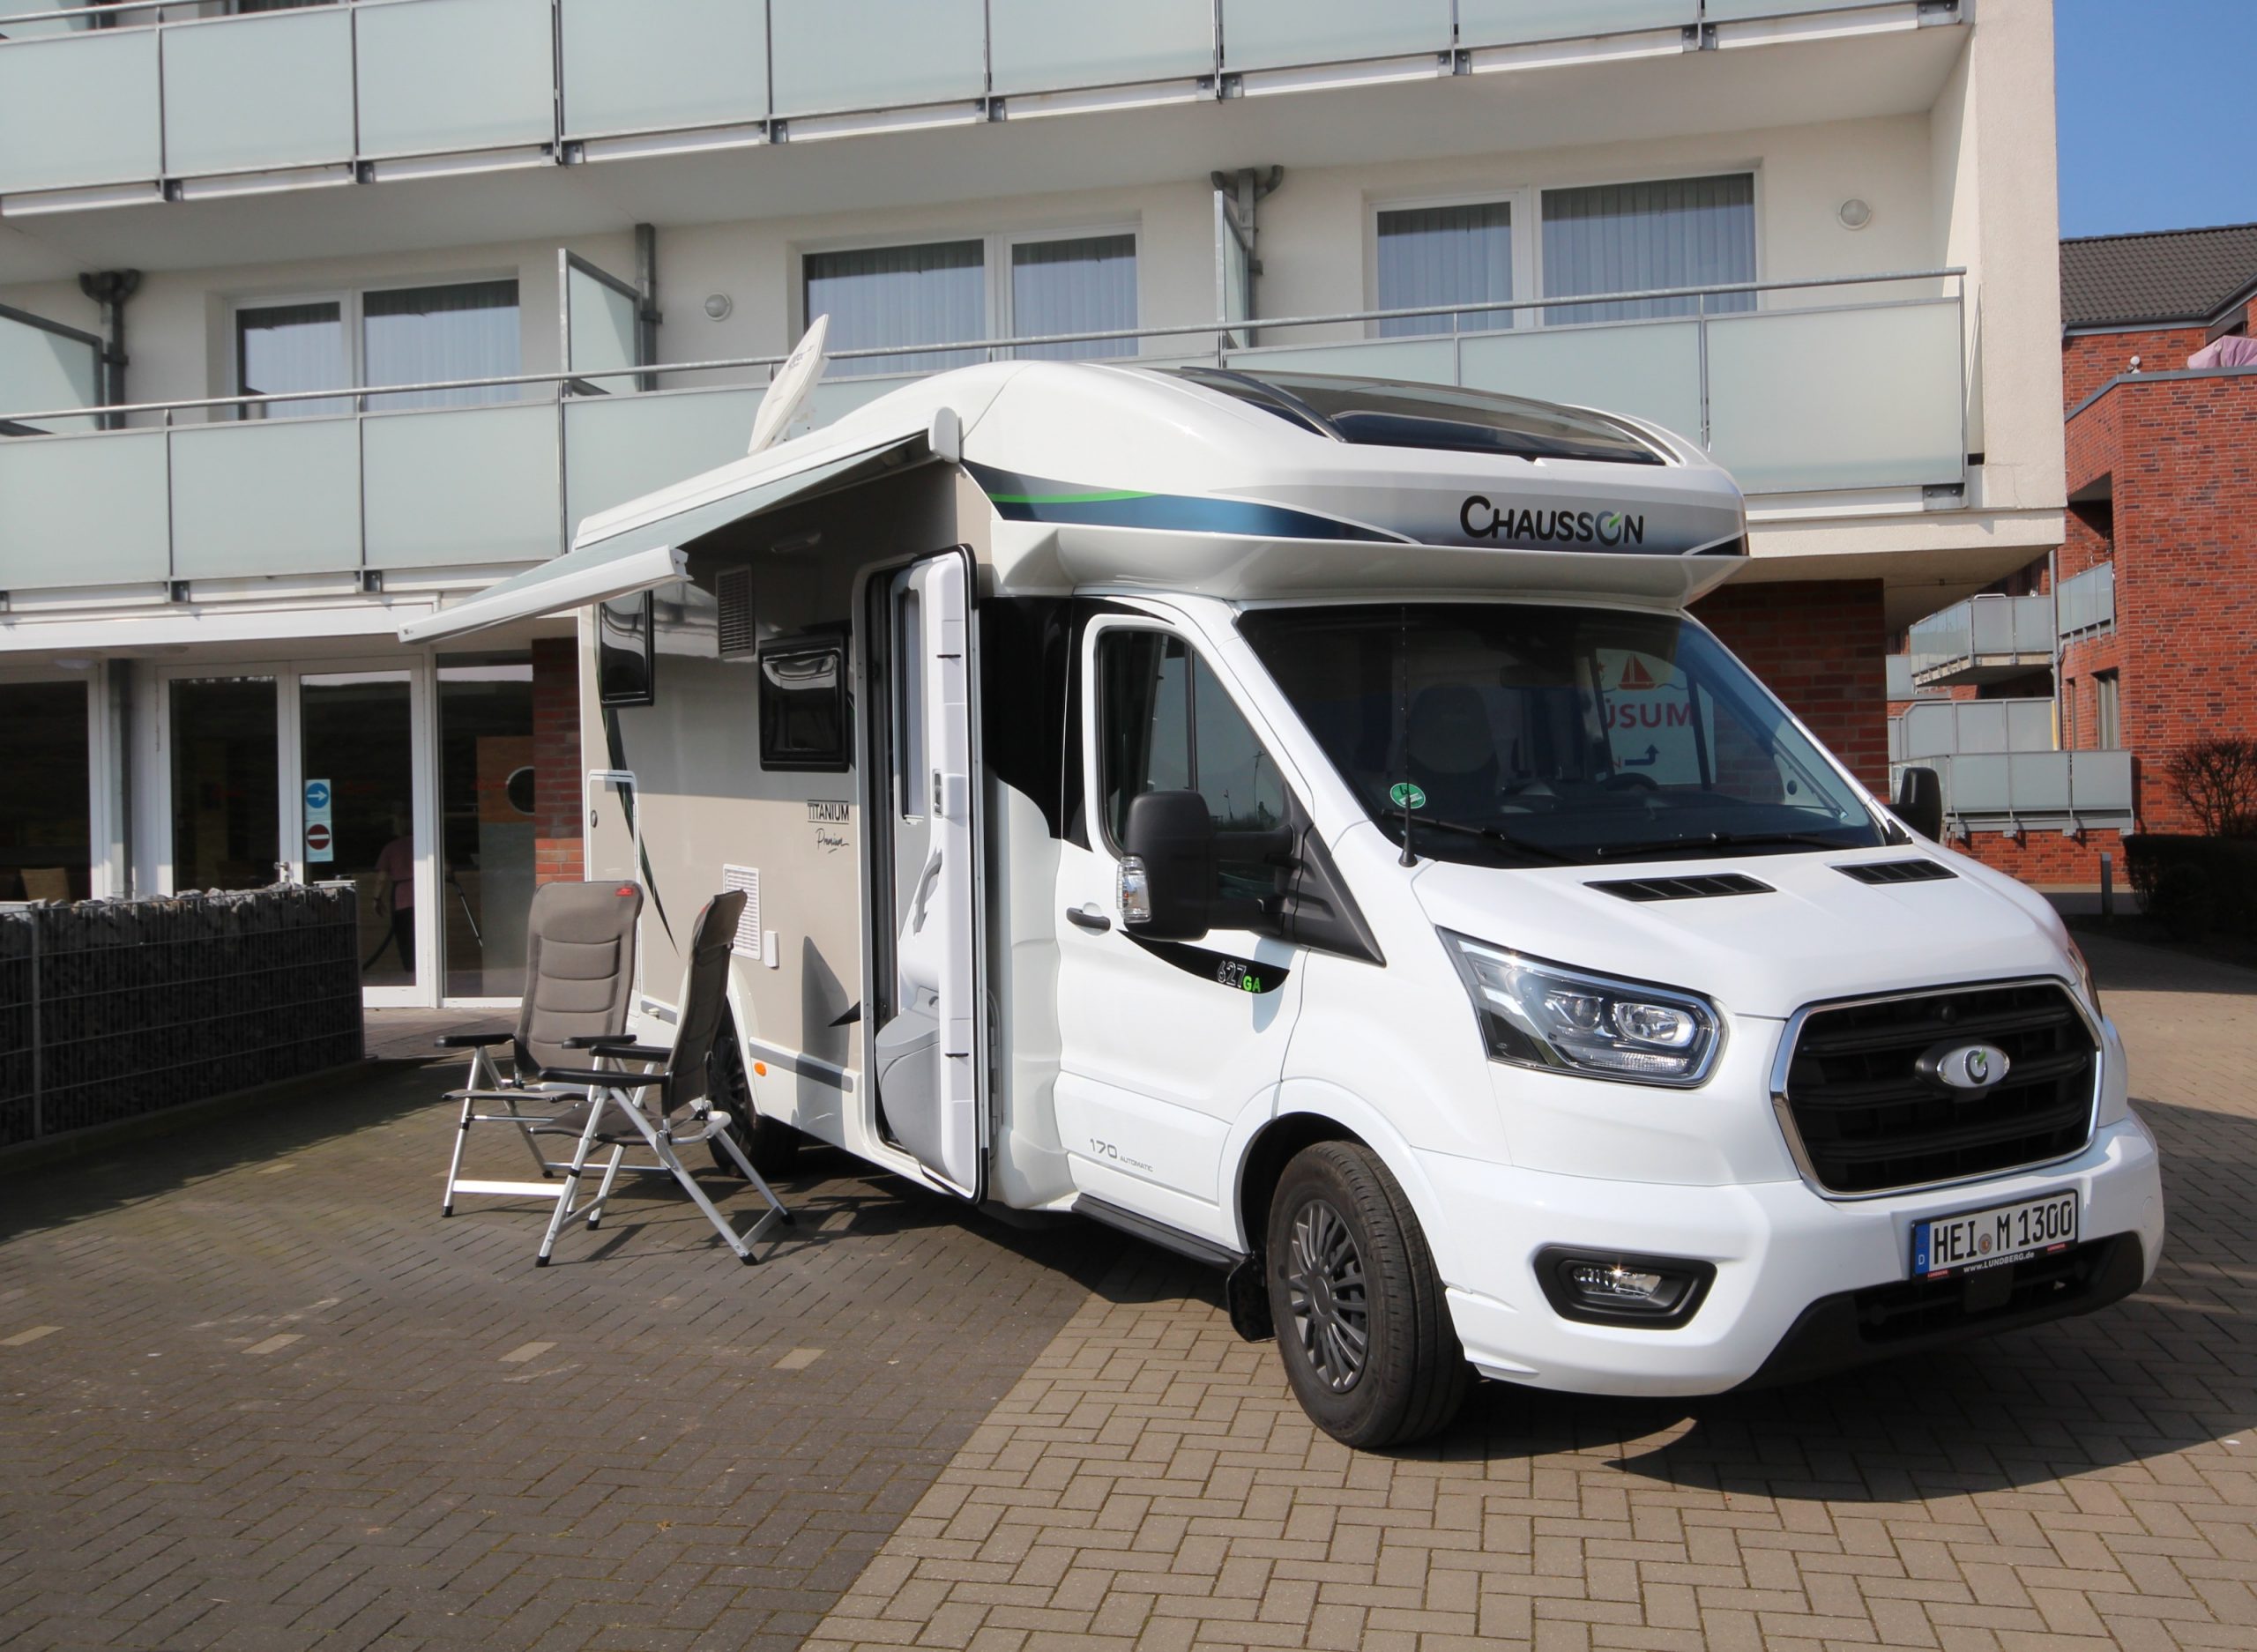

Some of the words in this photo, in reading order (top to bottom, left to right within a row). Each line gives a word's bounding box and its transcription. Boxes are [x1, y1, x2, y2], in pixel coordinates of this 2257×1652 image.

[1460, 495, 1643, 546] CHAUSSON
[808, 803, 849, 821] TITANIUM
[1090, 1138, 1117, 1159] 170
[1120, 1156, 1153, 1172] AUTOMATIC
[1933, 1220, 1978, 1265] HEI
[1997, 1213, 2011, 1251] M
[2018, 1201, 2072, 1246] 1300
[1918, 1254, 1926, 1265] D
[1963, 1252, 2035, 1273] www.LUNDBERG.de
